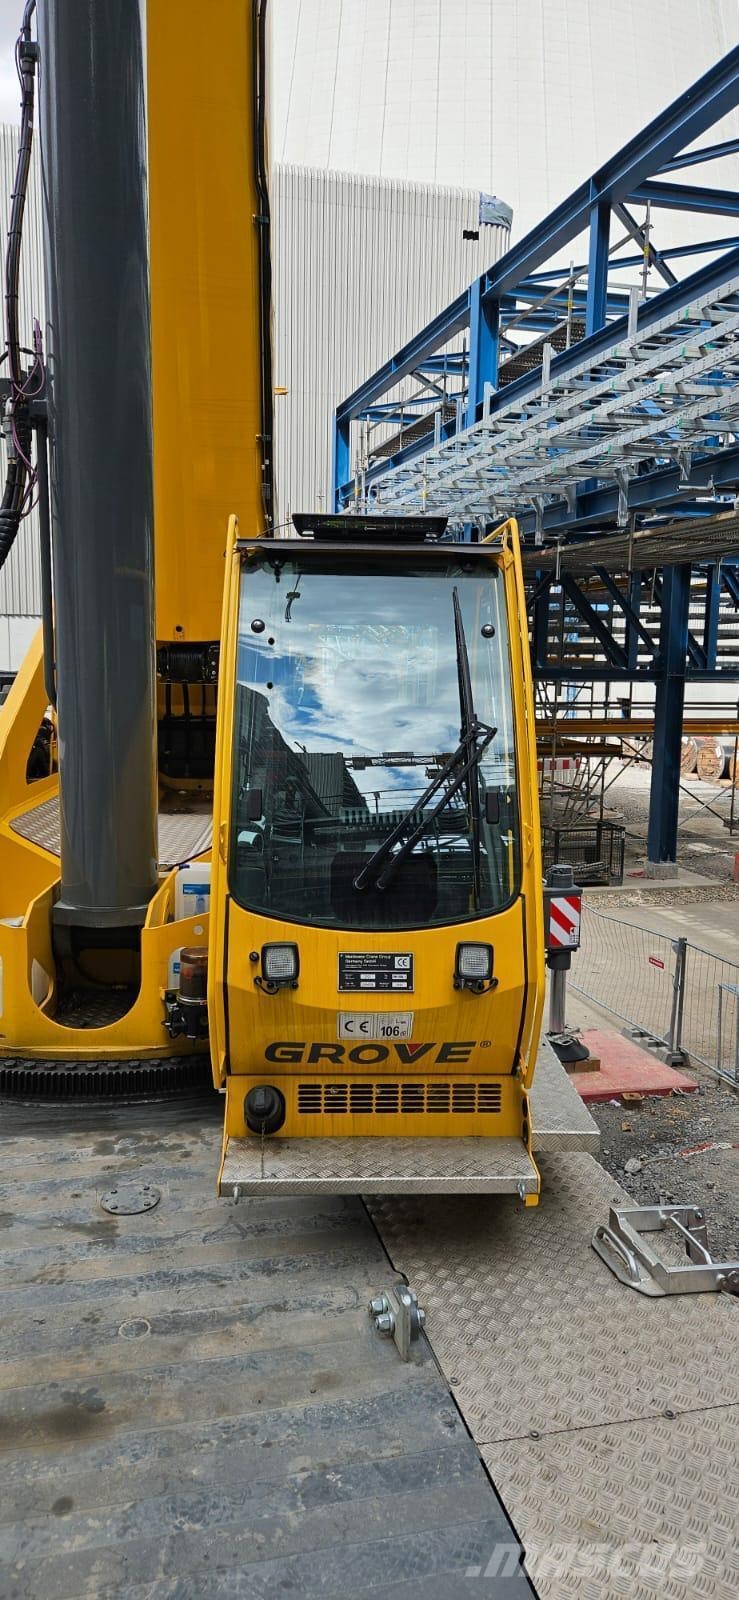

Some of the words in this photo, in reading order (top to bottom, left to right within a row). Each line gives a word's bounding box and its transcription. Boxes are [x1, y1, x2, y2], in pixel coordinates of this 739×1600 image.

[397, 958, 408, 967] CE
[344, 1020, 369, 1033] CE
[380, 1026, 400, 1036] 106
[264, 1041, 477, 1064] GROVE
